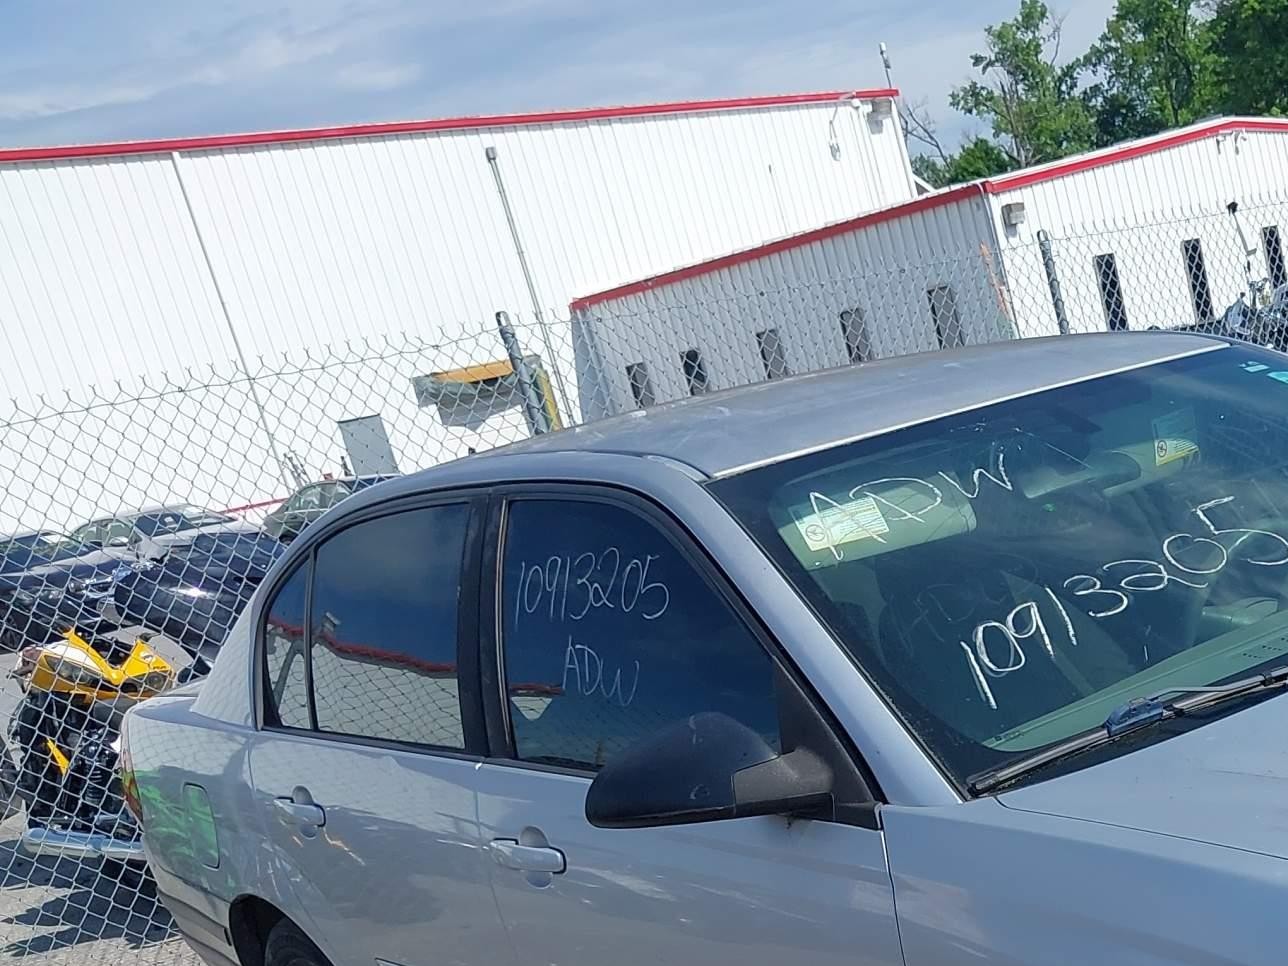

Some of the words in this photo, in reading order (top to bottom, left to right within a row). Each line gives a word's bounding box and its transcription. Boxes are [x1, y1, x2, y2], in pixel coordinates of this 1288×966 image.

[809, 446, 1013, 562] ADW
[514, 547, 669, 630] 10913205
[562, 635, 640, 706] ADW
